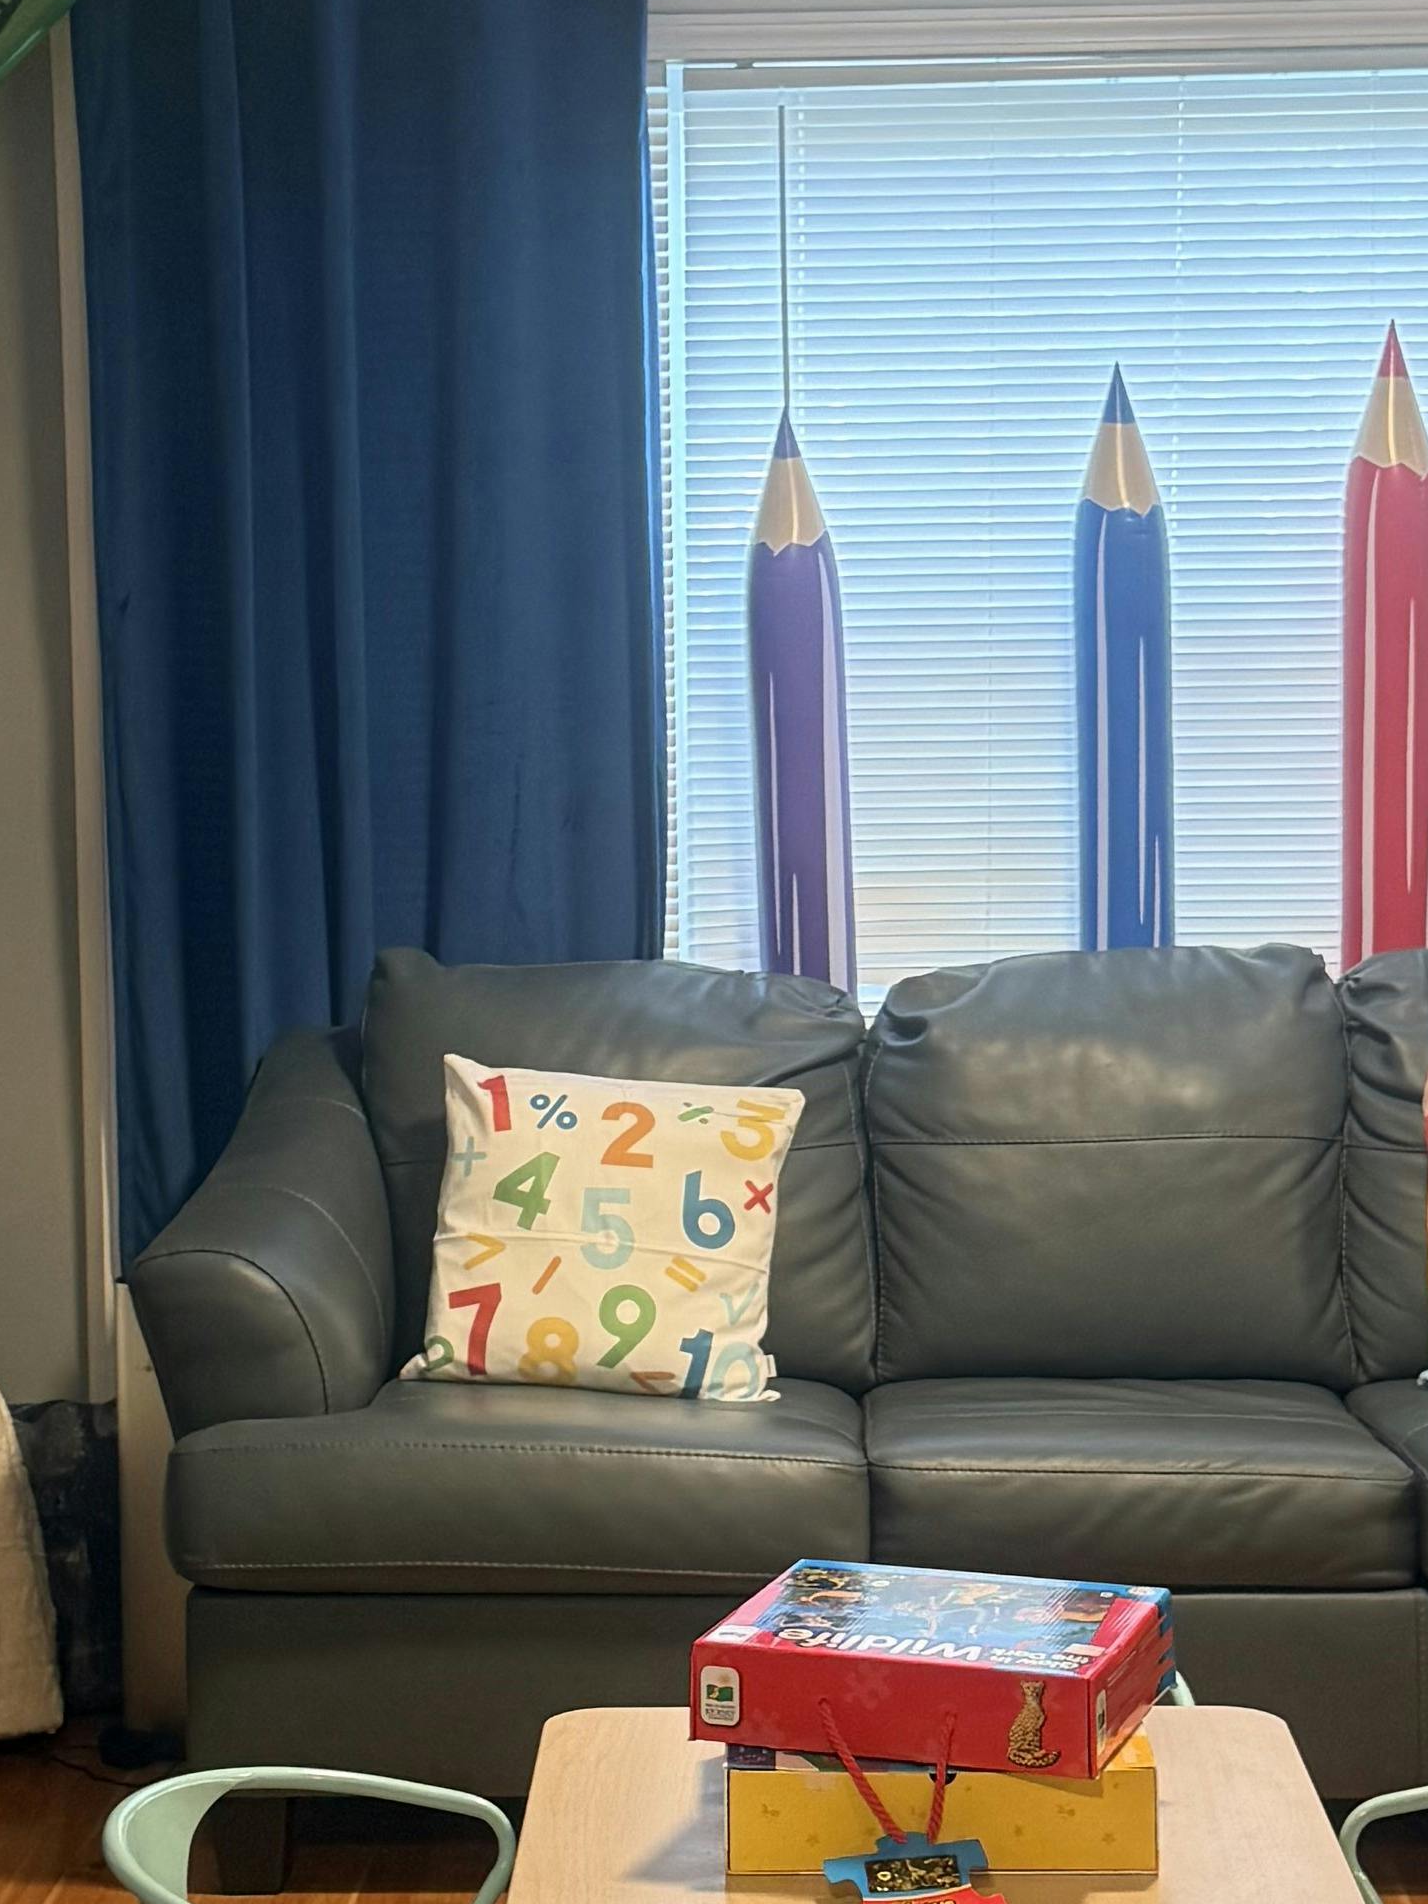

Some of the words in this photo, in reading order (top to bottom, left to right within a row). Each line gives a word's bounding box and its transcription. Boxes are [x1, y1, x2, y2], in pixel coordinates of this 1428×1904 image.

[477, 1075, 512, 1132] 1
[600, 1101, 657, 1169] 2
[492, 1151, 561, 1231] 4
[580, 1187, 635, 1270] 5
[682, 1170, 735, 1250] 6
[448, 1282, 503, 1377] 7
[518, 1316, 580, 1383] 8
[596, 1284, 657, 1369] 9
[777, 1628, 982, 1661] Wildlife
